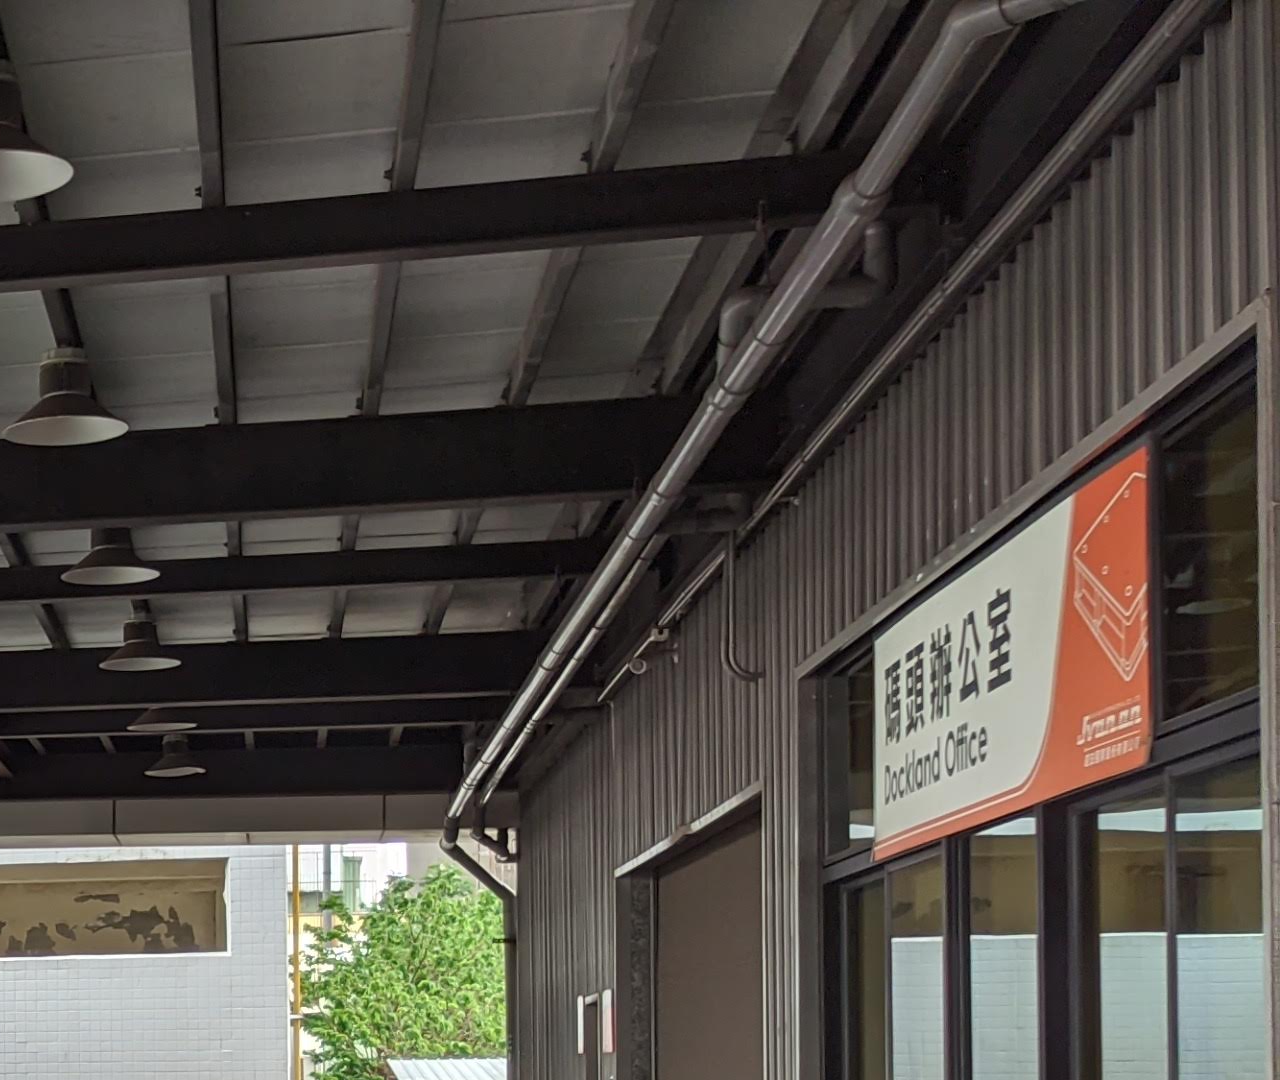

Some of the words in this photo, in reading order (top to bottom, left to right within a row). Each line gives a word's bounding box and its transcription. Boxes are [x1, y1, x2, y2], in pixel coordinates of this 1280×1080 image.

[884, 588, 1012, 747] 碼頭辦公室
[884, 735, 941, 806] Dockland
[944, 722, 989, 778] Office
